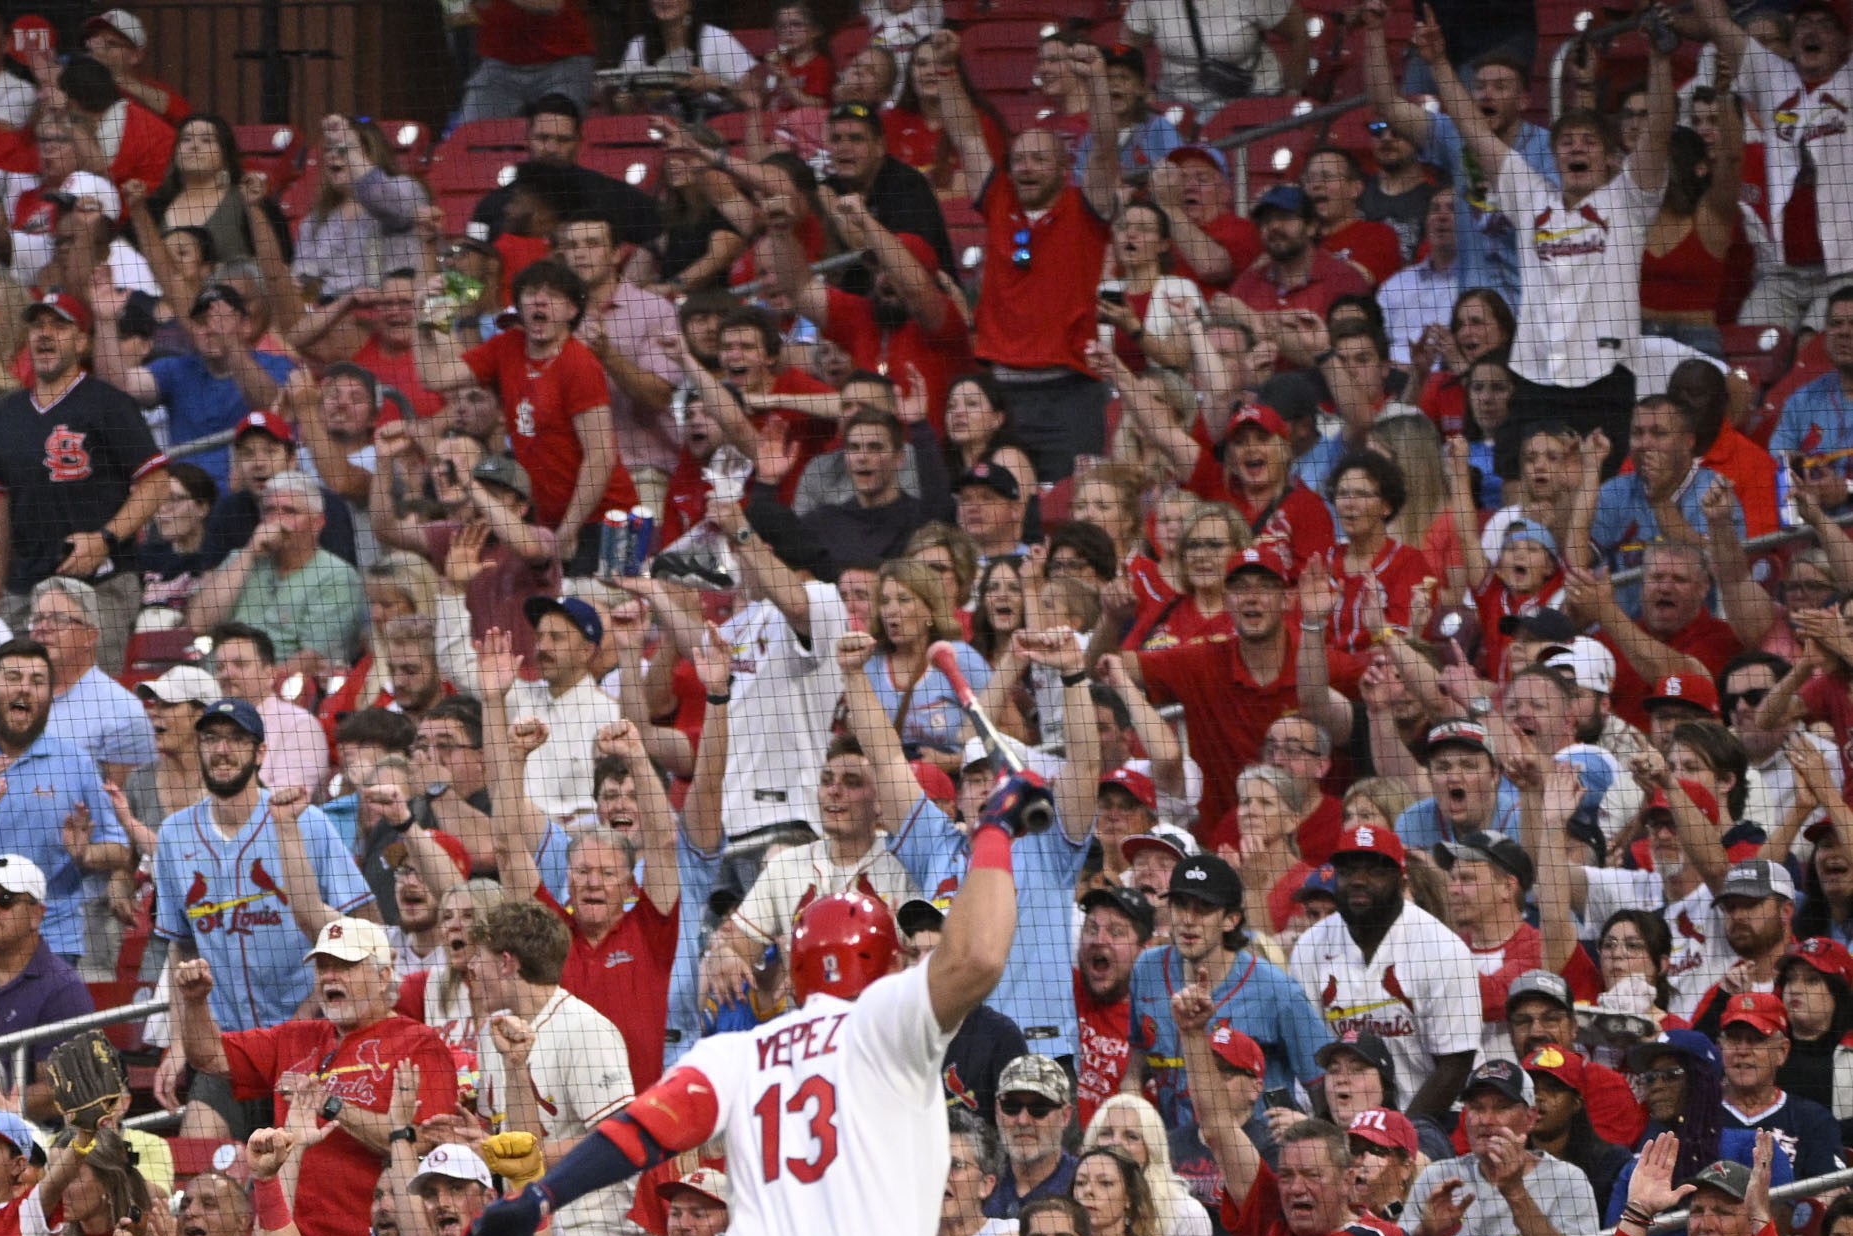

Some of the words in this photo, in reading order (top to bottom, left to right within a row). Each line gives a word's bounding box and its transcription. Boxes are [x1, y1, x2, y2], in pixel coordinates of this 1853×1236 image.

[226, 902, 284, 934] Louis
[756, 1012, 849, 1072] YEPEZ
[753, 1074, 838, 1185] 13
[1351, 1110, 1387, 1131] STL
